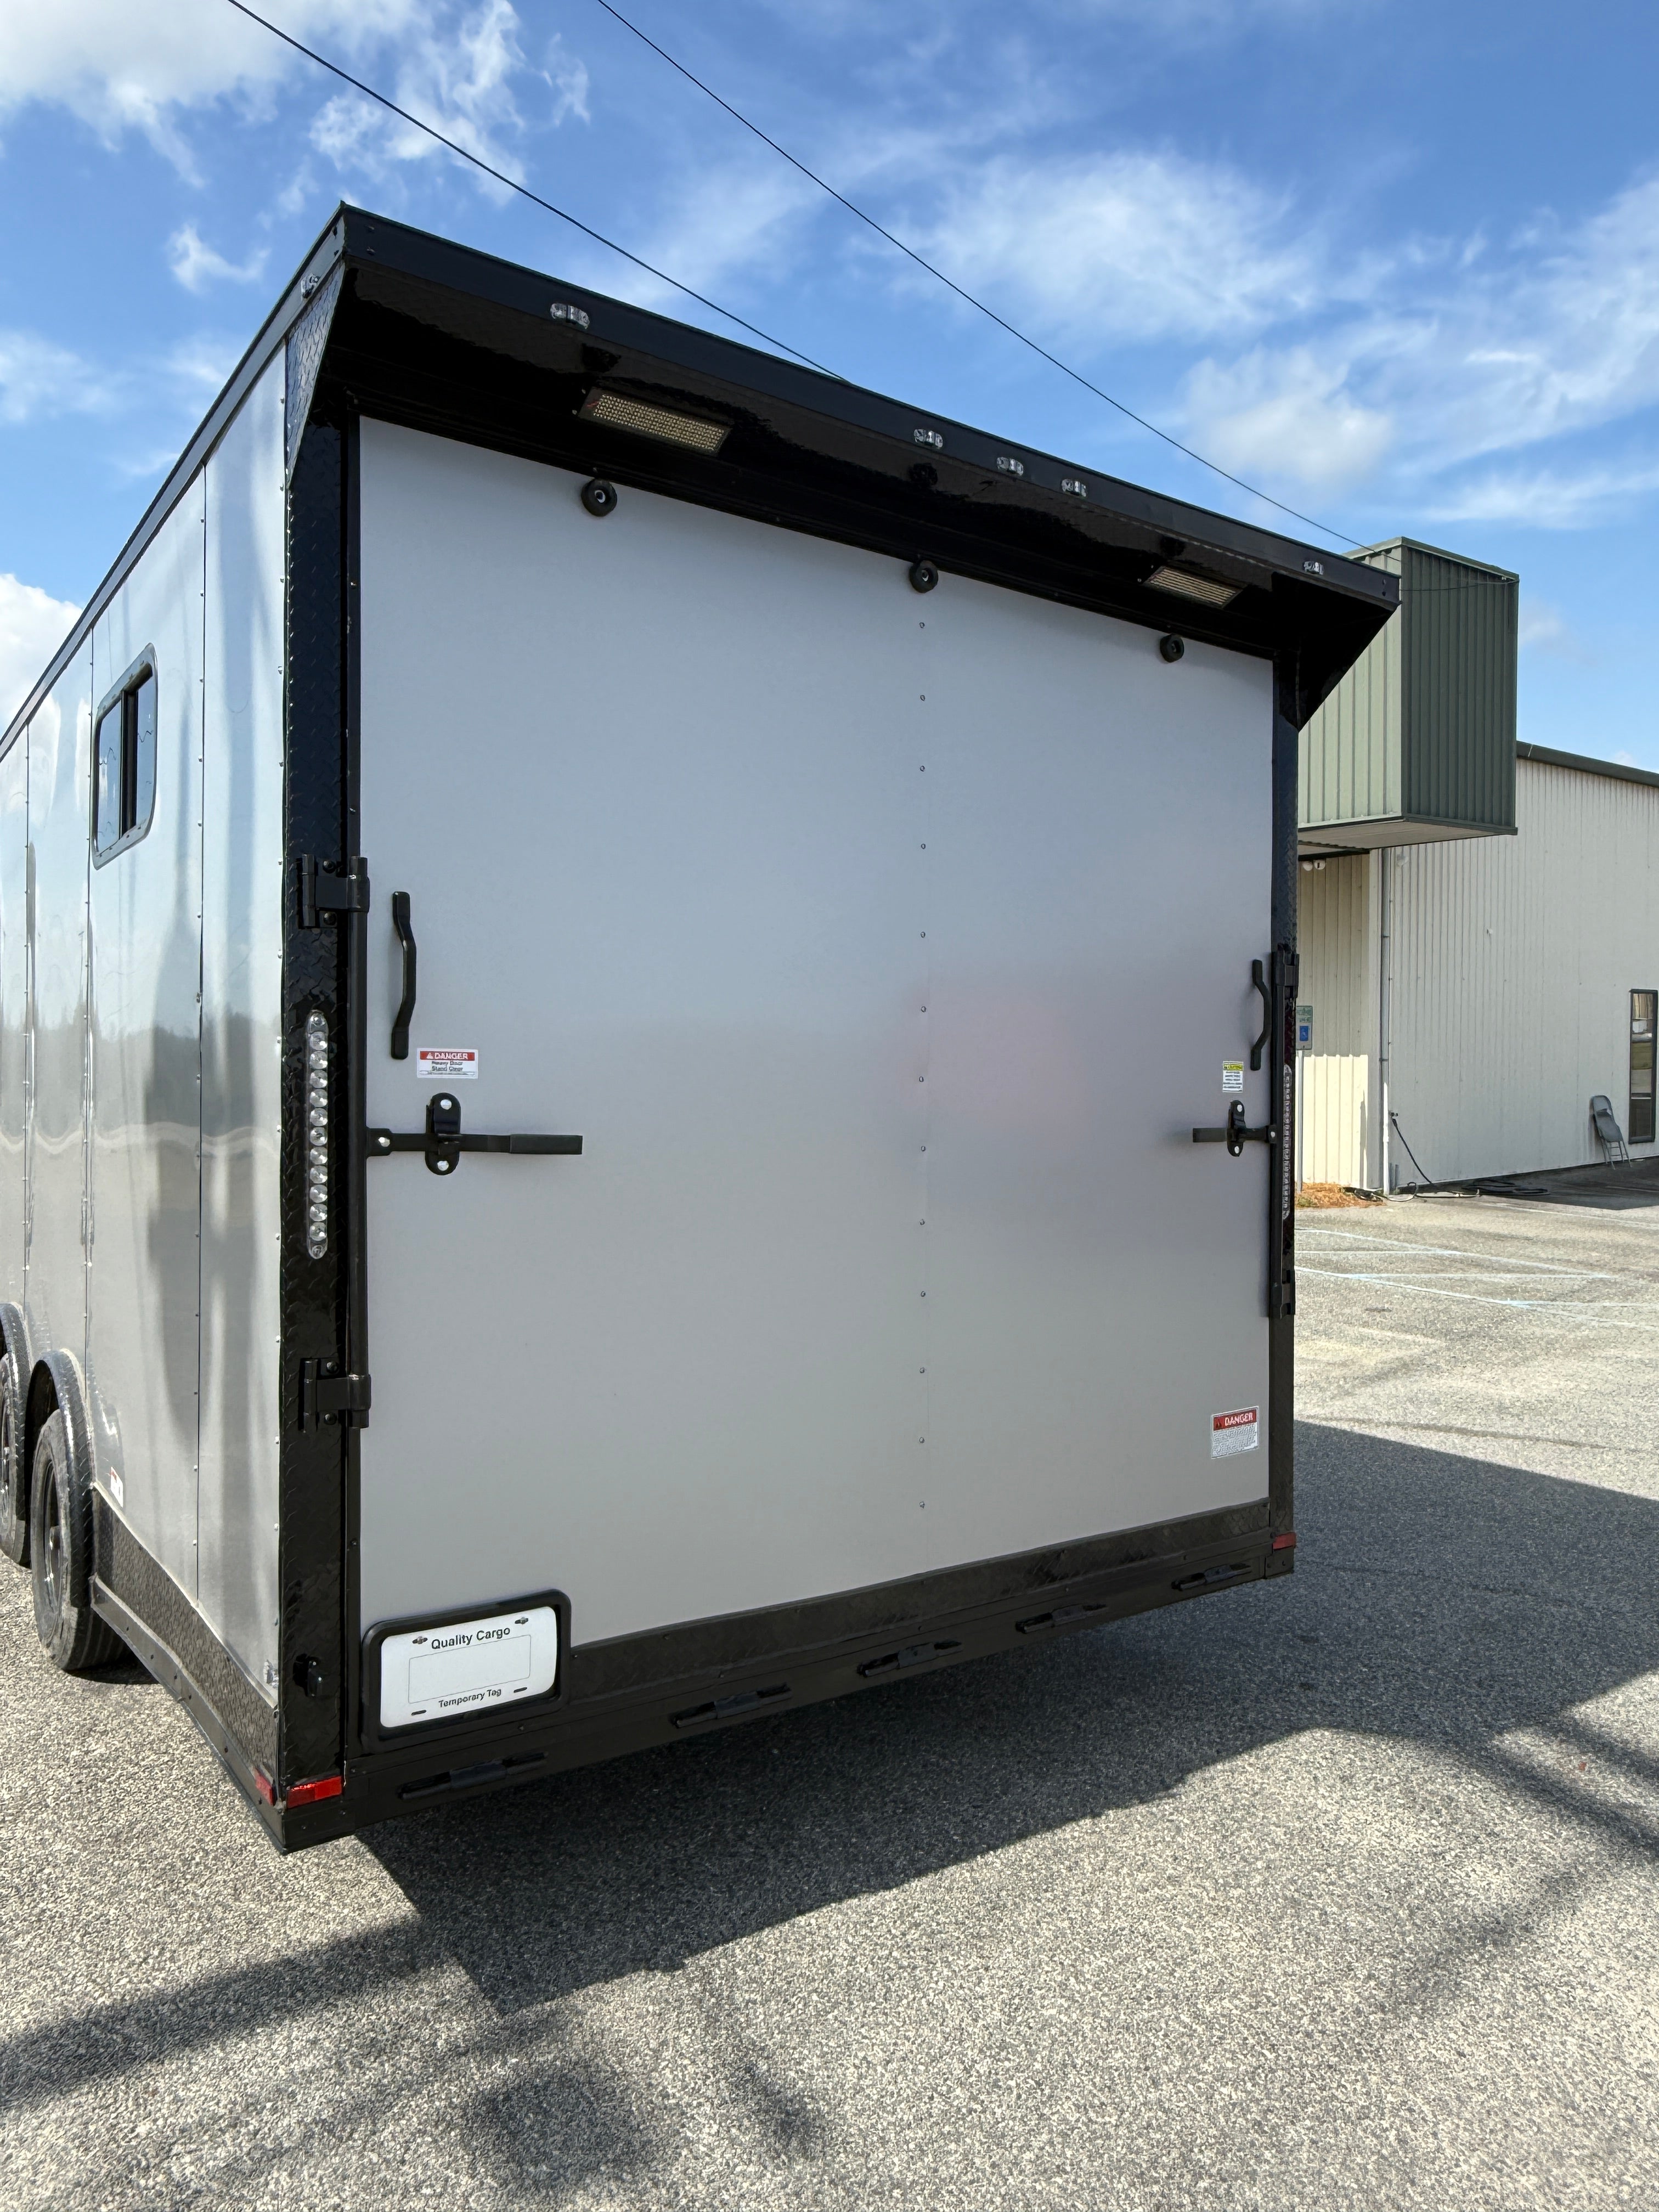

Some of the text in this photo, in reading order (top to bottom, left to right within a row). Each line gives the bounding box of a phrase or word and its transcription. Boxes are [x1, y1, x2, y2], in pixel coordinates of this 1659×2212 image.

[1225, 1413, 1253, 1426] DANGER
[431, 1628, 510, 1649] Quality Cargo
[438, 1688, 502, 1707] Temporary Tag
